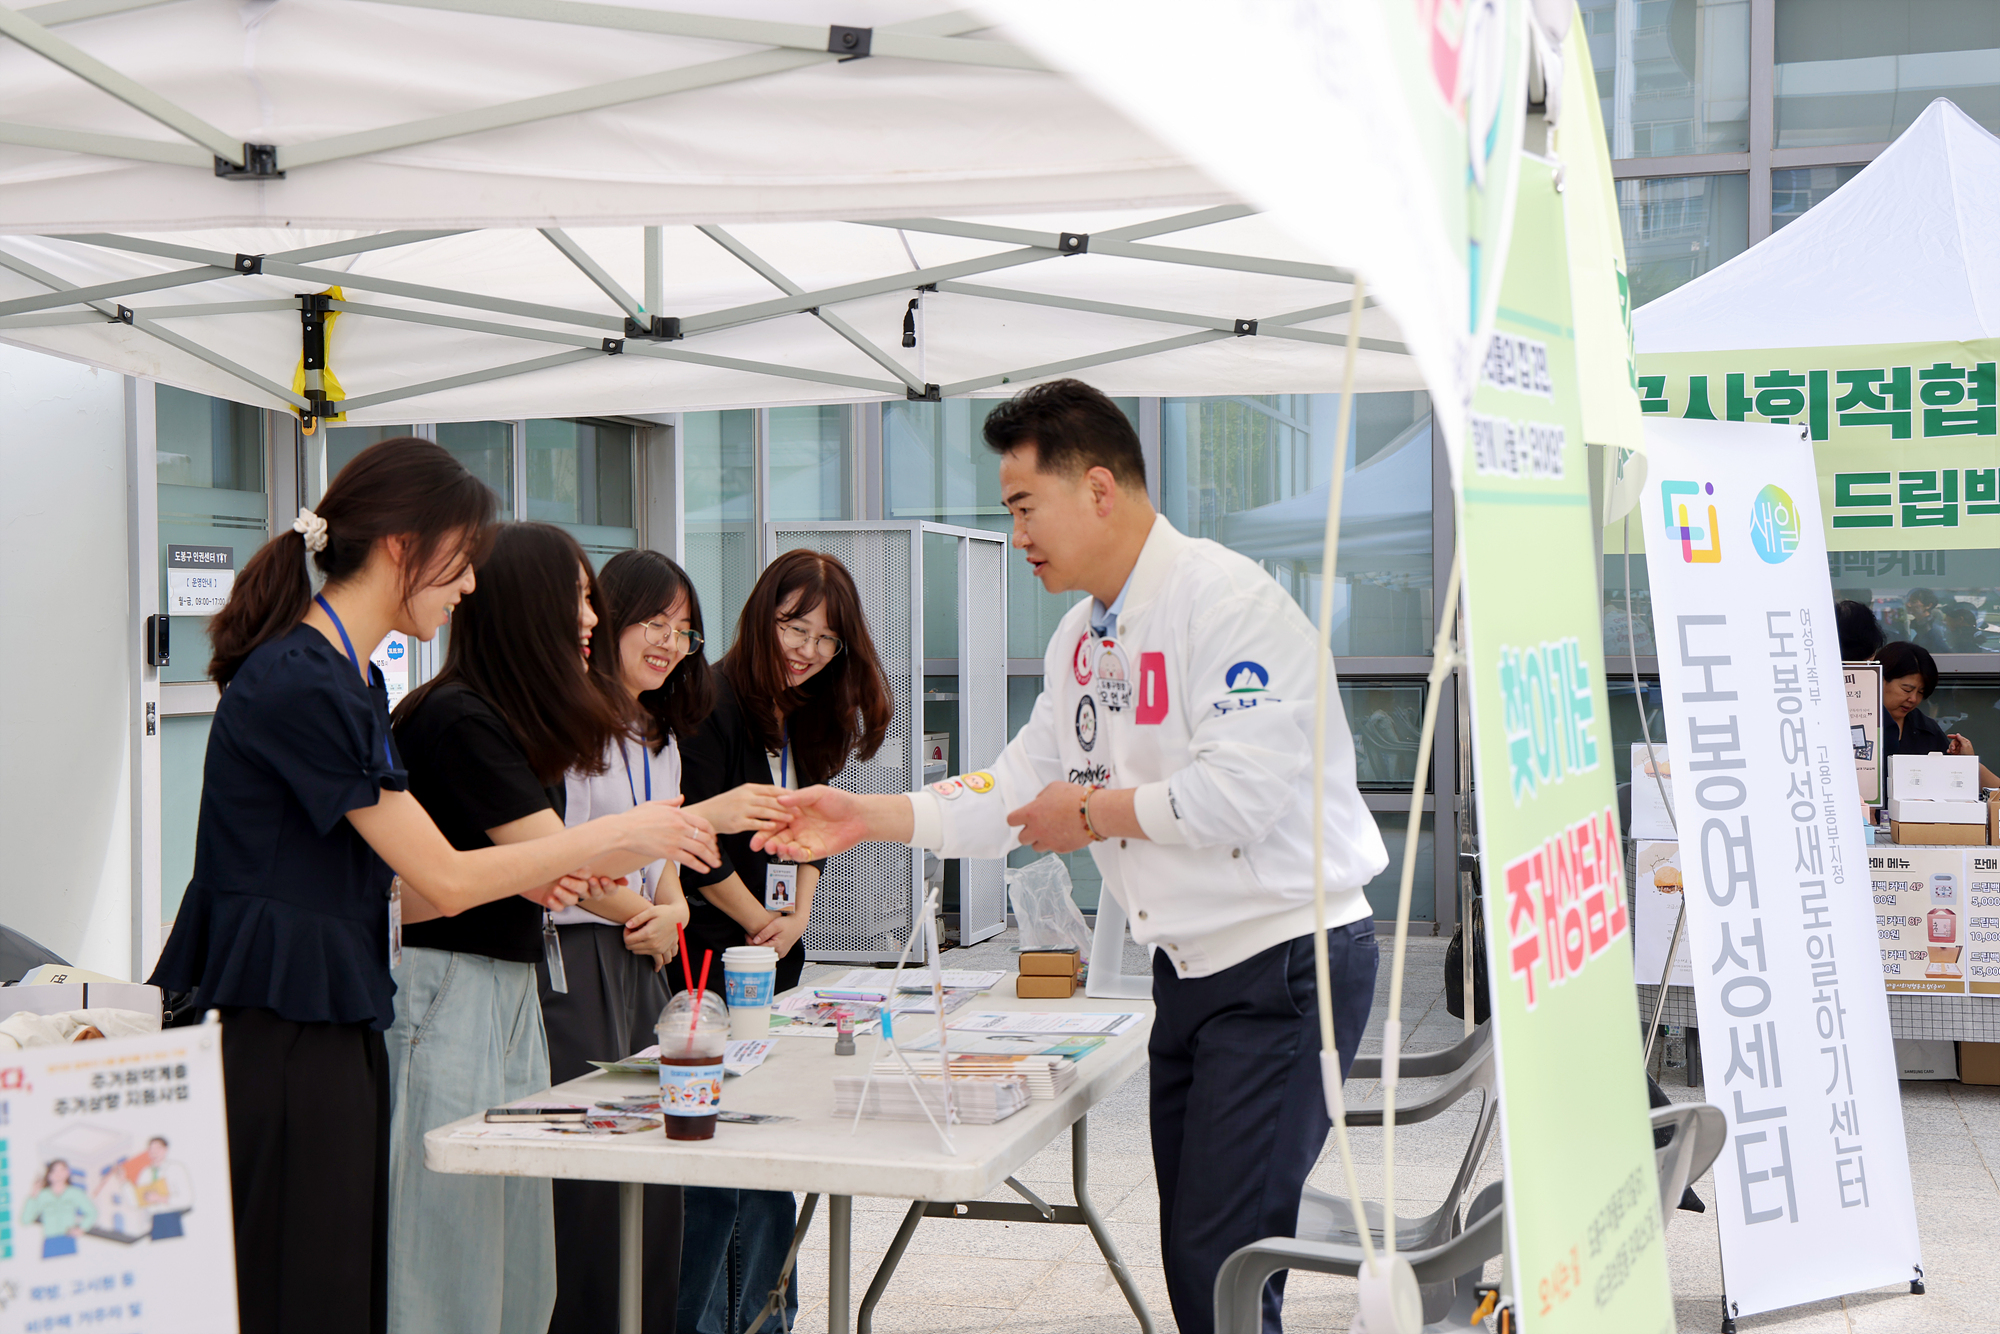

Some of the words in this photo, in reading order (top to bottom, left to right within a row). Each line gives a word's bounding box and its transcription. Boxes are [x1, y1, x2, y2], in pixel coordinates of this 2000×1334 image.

[1750, 502, 1799, 553] 새일
[175, 551, 192, 562] 도봉구
[193, 552, 215, 563] 인권센터
[1829, 550, 1946, 578] 백커피
[1136, 652, 1168, 724] D
[1499, 638, 1599, 803] 찾아가는
[1800, 608, 1821, 706] 여성가족부
[1816, 746, 1845, 885] 고용노동부지정
[1887, 858, 1910, 869] 메뉴
[1974, 858, 1998, 870] 판매
[1871, 880, 1887, 891] 립백
[1889, 880, 1908, 892] 커피
[1910, 882, 1924, 891] 4P
[1971, 882, 2000, 893] 드립백
[1873, 895, 1897, 905] 00원
[1505, 808, 1628, 1008] 주거상담소
[1766, 611, 1869, 1209] 도봉여성새로일하기센터
[1677, 614, 1799, 1226] 도봉여성센터
[1887, 916, 1906, 926] 커피
[1908, 917, 1922, 926] 8P
[1970, 917, 1999, 928] 드립백
[1878, 930, 1900, 940] 00원
[1888, 950, 1907, 960] 커피
[1909, 951, 1928, 960] 12P
[1970, 952, 2000, 963] 드립백
[1970, 966, 2000, 977] 15,00
